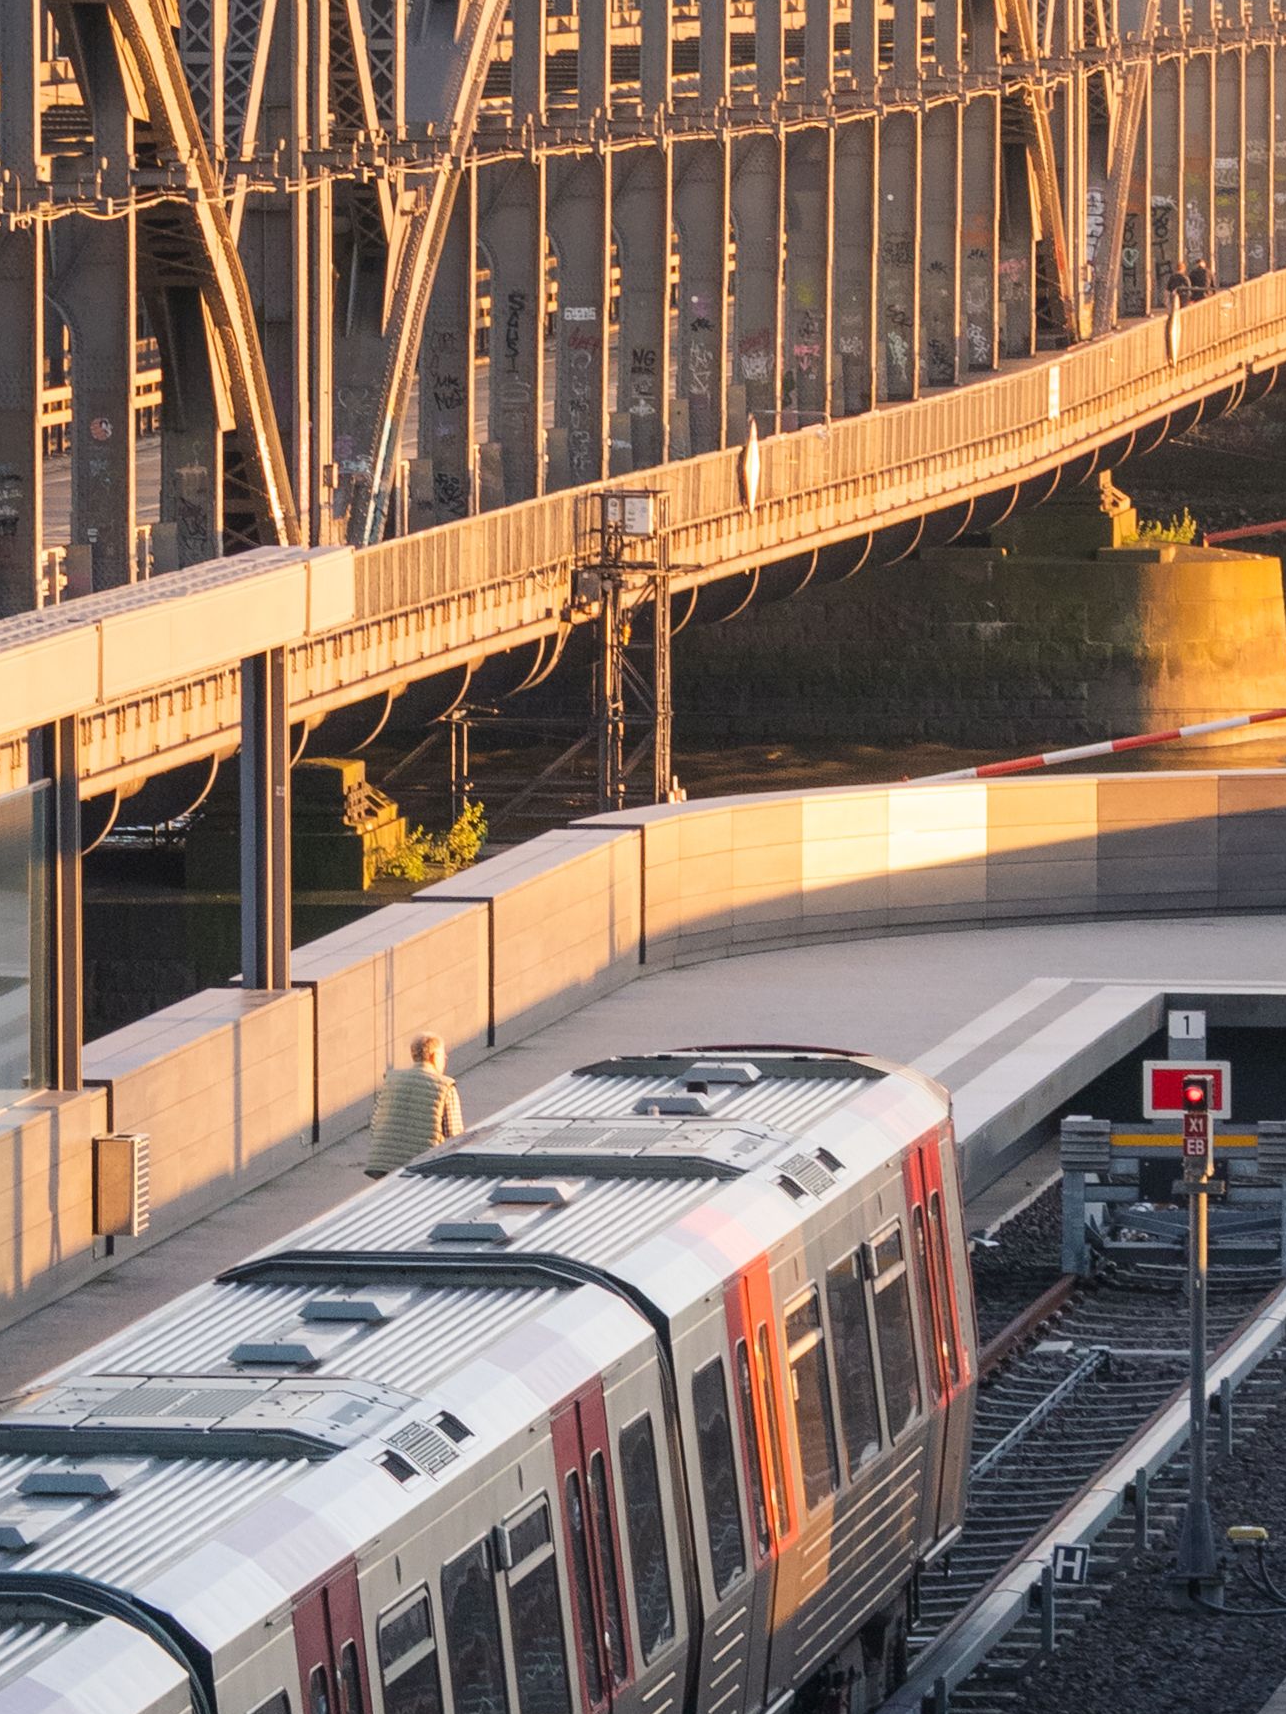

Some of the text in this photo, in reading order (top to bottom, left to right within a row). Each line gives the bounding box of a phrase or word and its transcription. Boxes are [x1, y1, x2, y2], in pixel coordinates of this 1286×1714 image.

[1181, 1015, 1192, 1035] 1
[1187, 1117, 1205, 1134] X1
[1186, 1138, 1205, 1155] EB
[1055, 1549, 1082, 1581] H
